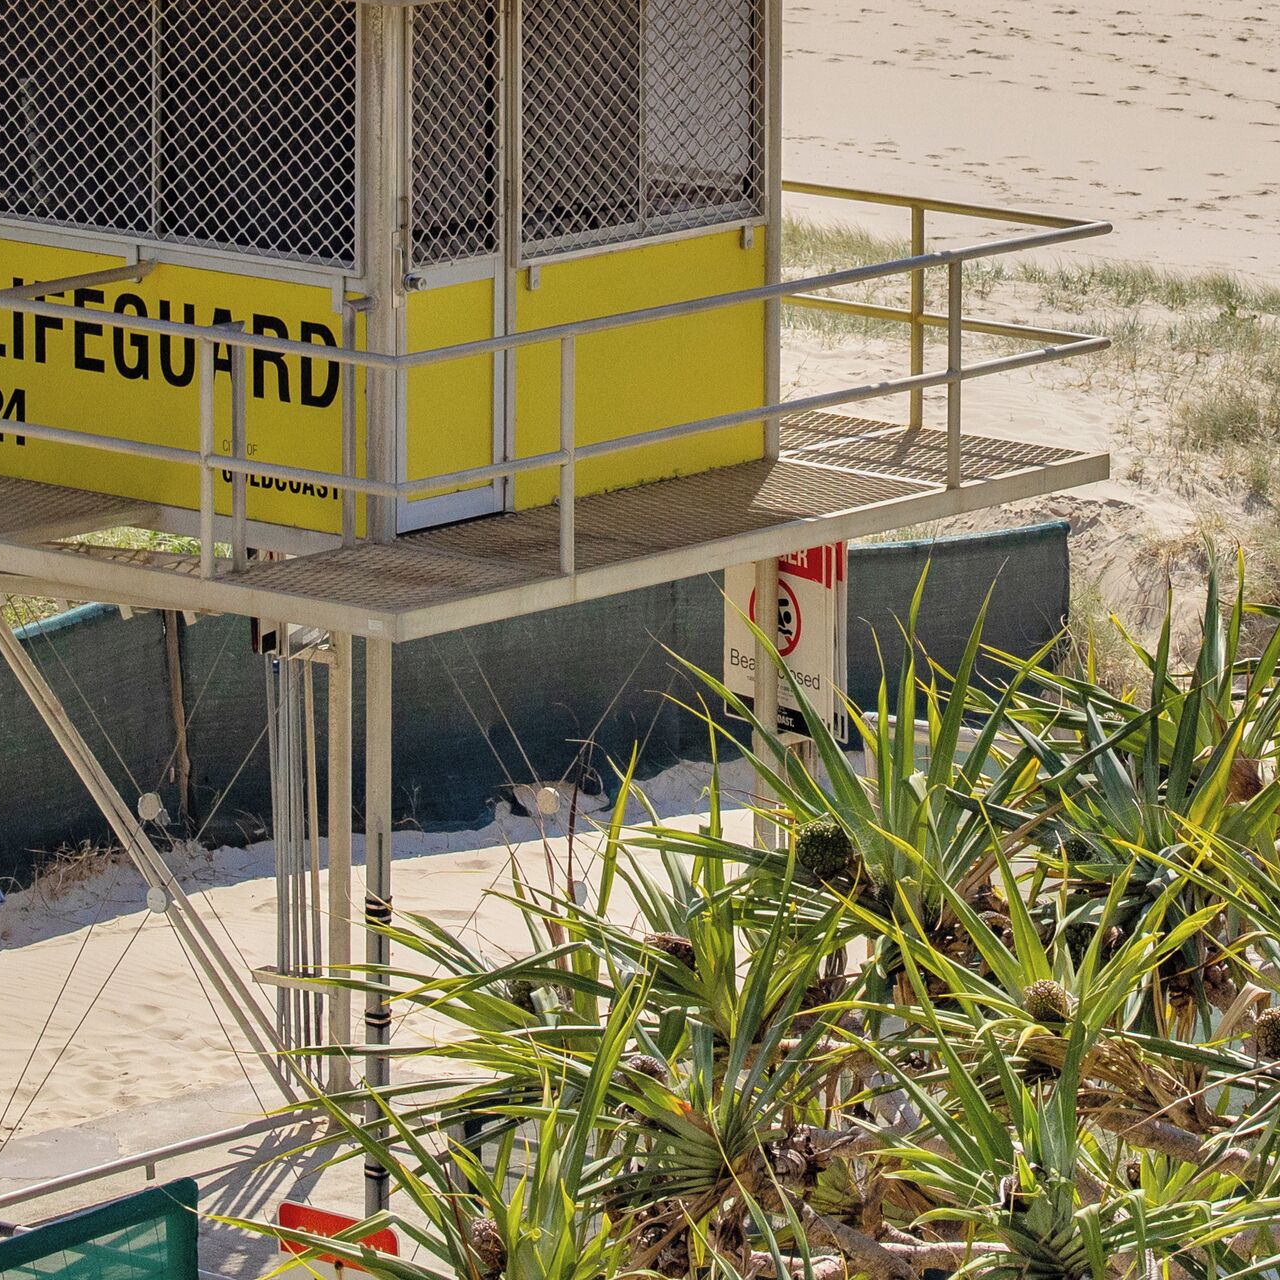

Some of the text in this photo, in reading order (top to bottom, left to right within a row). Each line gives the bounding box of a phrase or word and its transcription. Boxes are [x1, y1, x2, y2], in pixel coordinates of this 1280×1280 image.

[246, 443, 258, 455] OF
[223, 469, 338, 500] GLDCOAST
[730, 648, 755, 671] Bea
